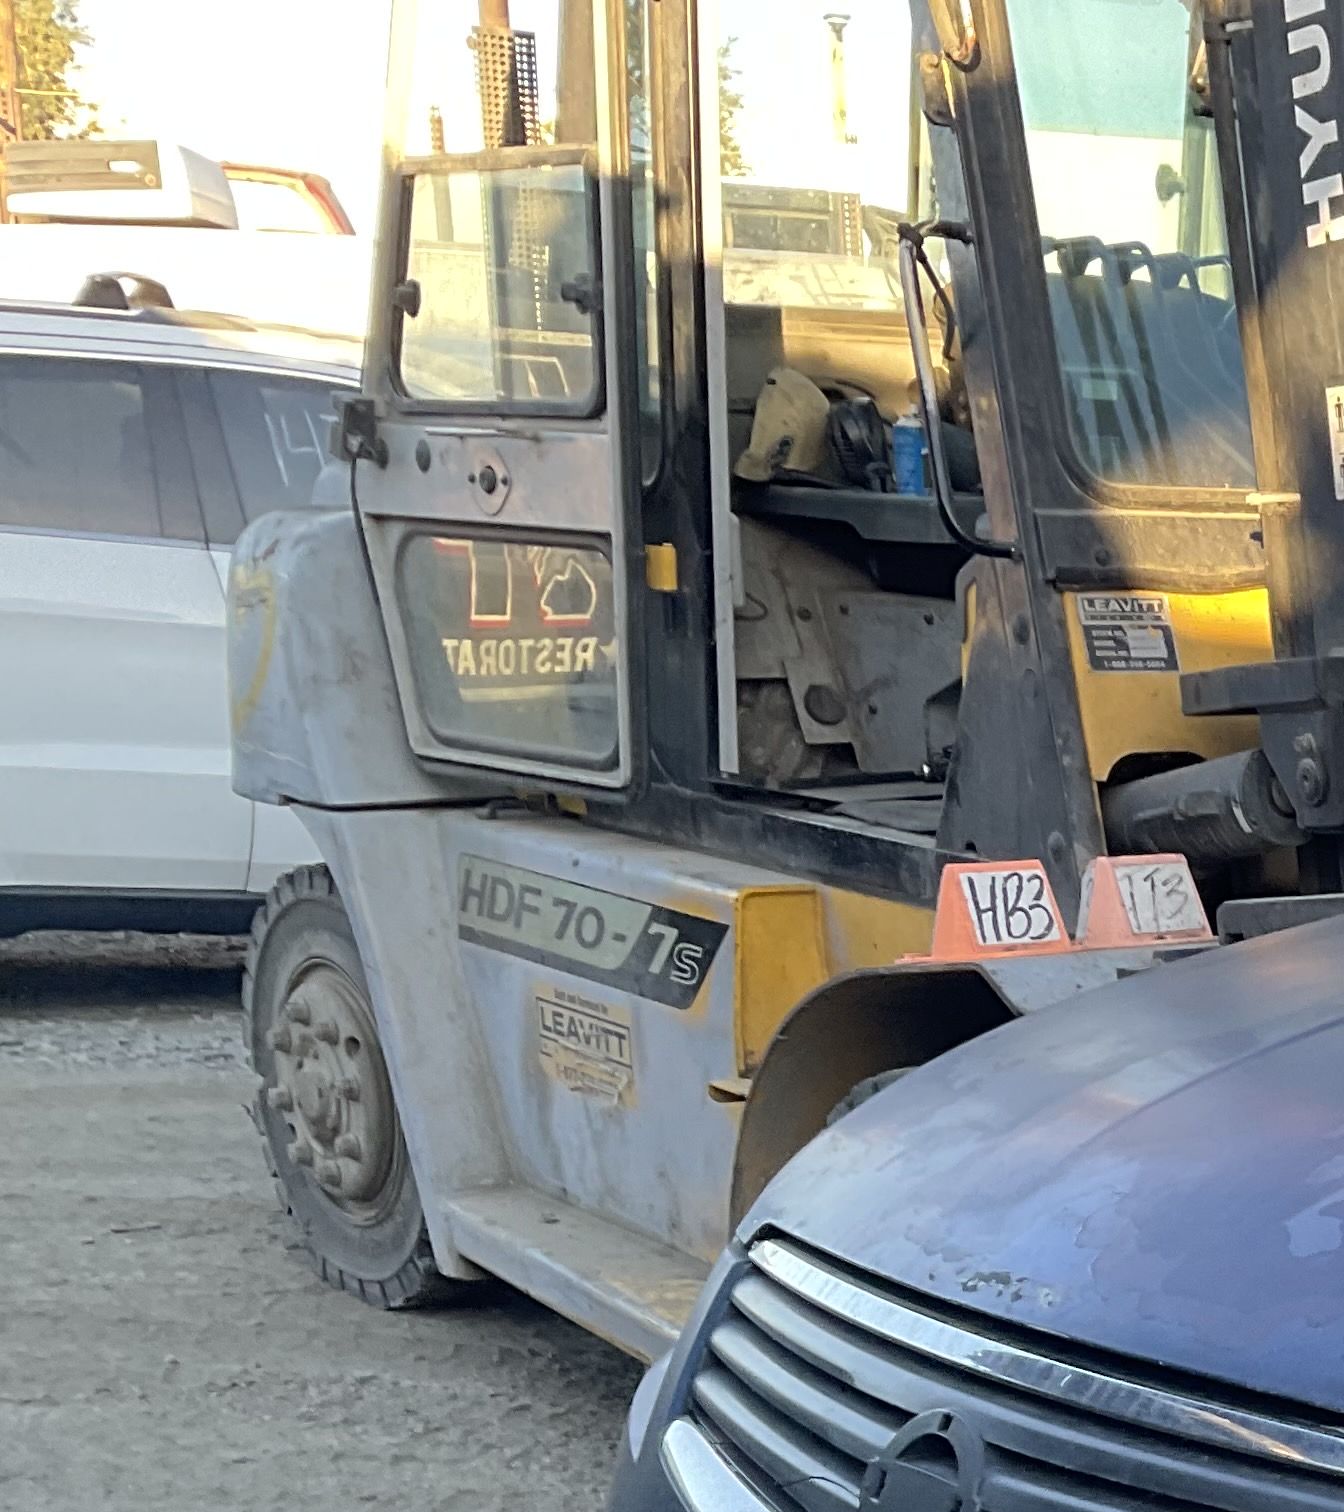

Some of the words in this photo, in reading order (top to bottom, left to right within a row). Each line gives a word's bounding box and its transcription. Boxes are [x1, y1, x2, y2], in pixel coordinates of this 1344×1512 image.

[263, 409, 339, 487] 14
[1083, 599, 1162, 612] LEAVITT
[460, 868, 542, 930] HDF
[967, 871, 1054, 943] HB3
[540, 1005, 626, 1058] LEAVITT
